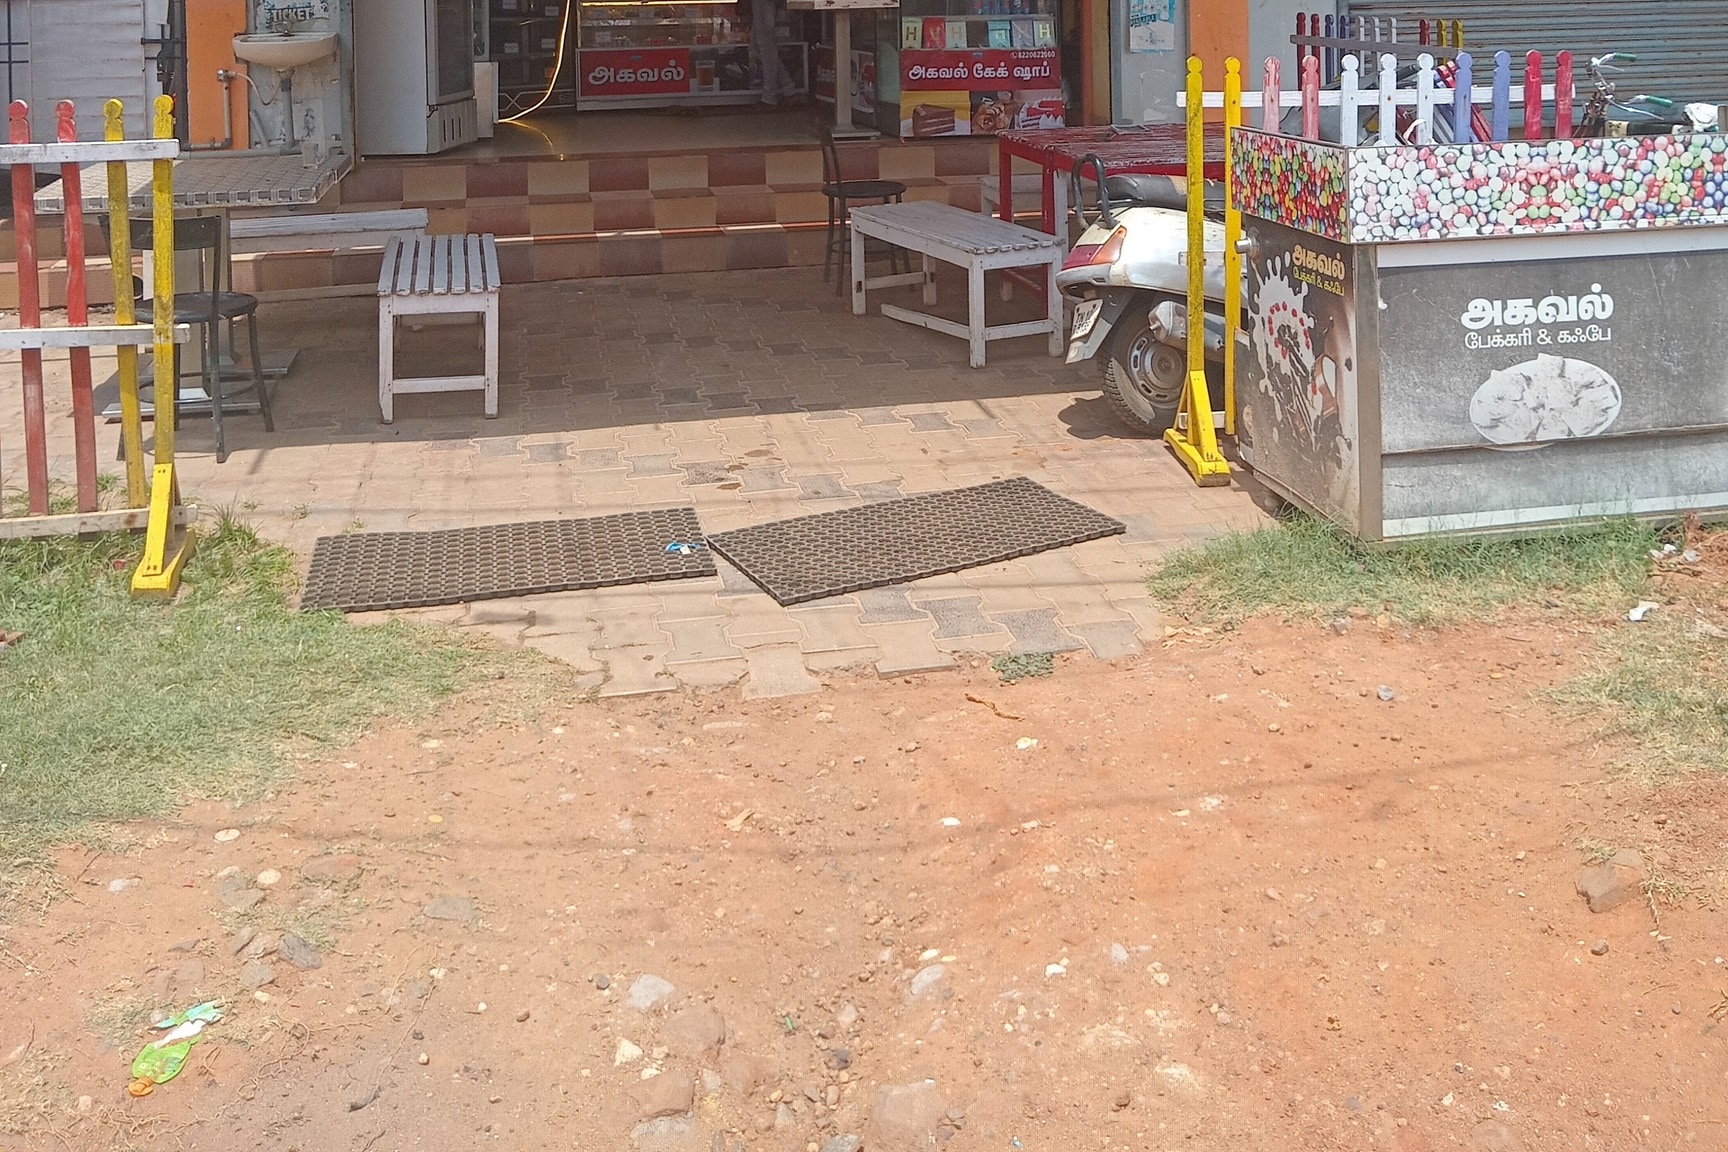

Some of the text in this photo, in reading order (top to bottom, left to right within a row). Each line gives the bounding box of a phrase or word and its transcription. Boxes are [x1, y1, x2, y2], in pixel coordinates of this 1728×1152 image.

[588, 59, 685, 85] அகவல்
[908, 60, 1051, 81] அகவல் கேக் ஷாப்
[1292, 244, 1345, 280] அகவல்
[1460, 282, 1614, 329] அகவல்
[1464, 324, 1611, 349] பேக்கரி & கஃபே
